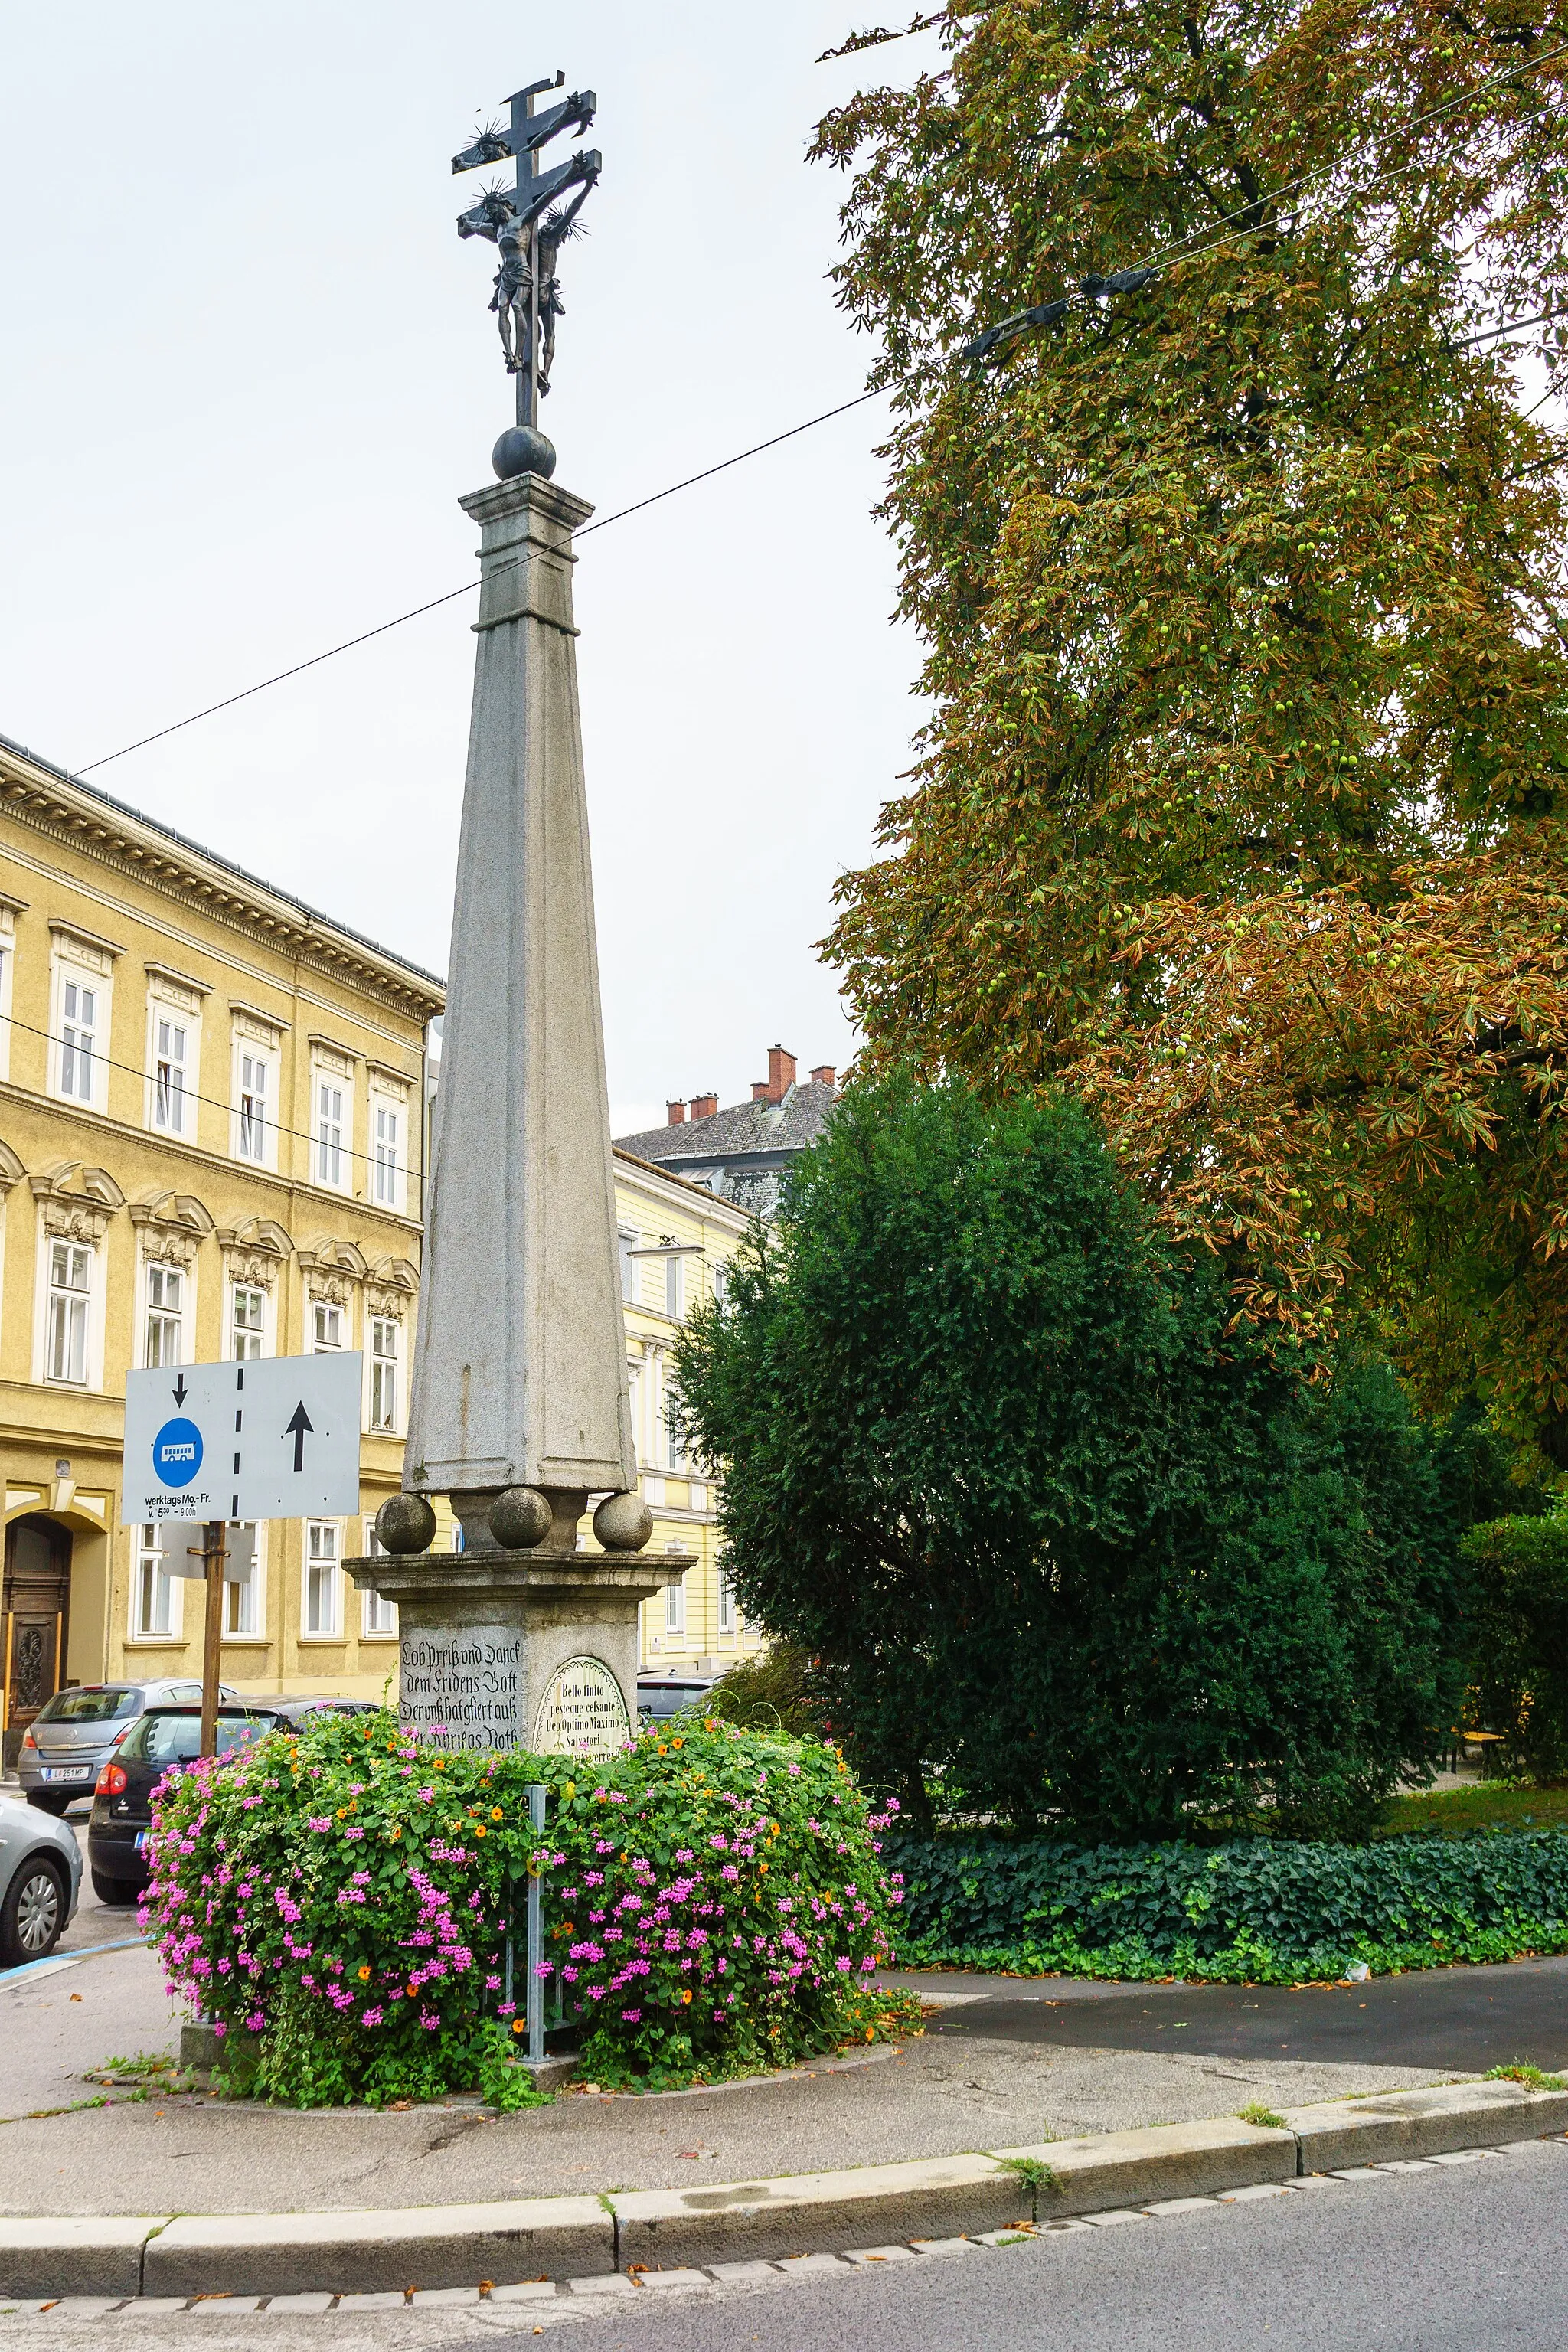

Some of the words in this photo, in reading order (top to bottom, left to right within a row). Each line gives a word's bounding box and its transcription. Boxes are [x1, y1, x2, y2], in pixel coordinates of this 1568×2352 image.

[145, 1495, 181, 1507] werktags
[148, 1510, 154, 1518] v.
[180, 1508, 197, 1517] 9.00h
[402, 1642, 426, 1667] Lob
[562, 1684, 582, 1697] Bello
[583, 1684, 604, 1697] finito
[550, 1704, 583, 1718] pesteque
[546, 1720, 560, 1732] Deo
[561, 1718, 589, 1733] Optimo
[590, 1717, 619, 1730] Maximo
